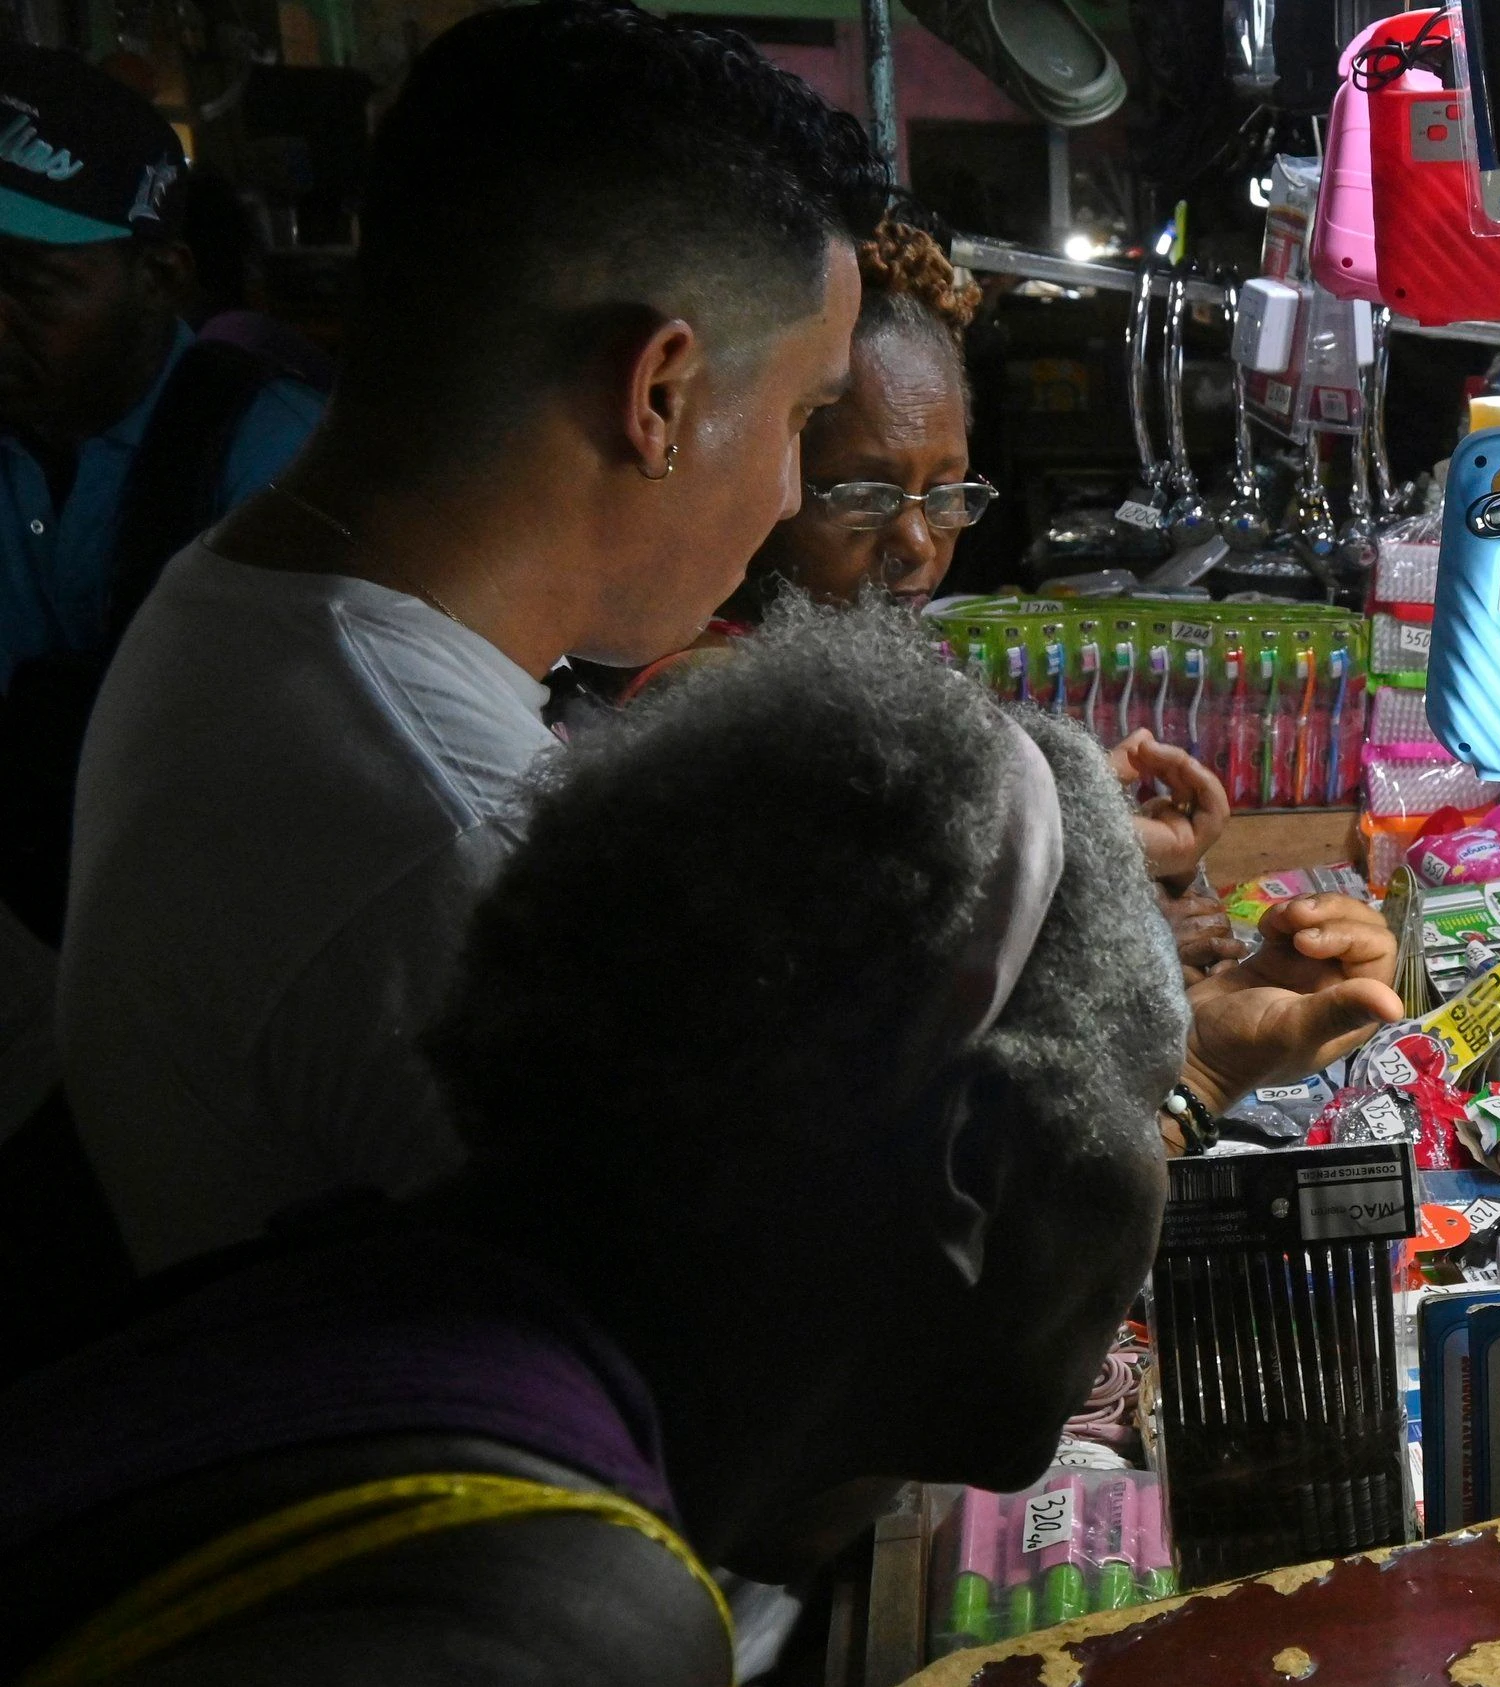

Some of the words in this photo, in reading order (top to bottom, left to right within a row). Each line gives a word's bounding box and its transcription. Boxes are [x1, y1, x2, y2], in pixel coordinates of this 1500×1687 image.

[1176, 624, 1210, 639] 1200
[1405, 629, 1430, 648] 350
[1423, 855, 1445, 880] 350
[1456, 1014, 1490, 1053] USB
[1379, 1051, 1413, 1084] 250
[1262, 1087, 1302, 1099] 300
[1366, 1102, 1400, 1120] 85
[1301, 1169, 1337, 1180] PENCIL
[1339, 1164, 1397, 1177] COSMETICS
[1347, 1201, 1394, 1221] MAC
[1030, 1495, 1066, 1531] 320
